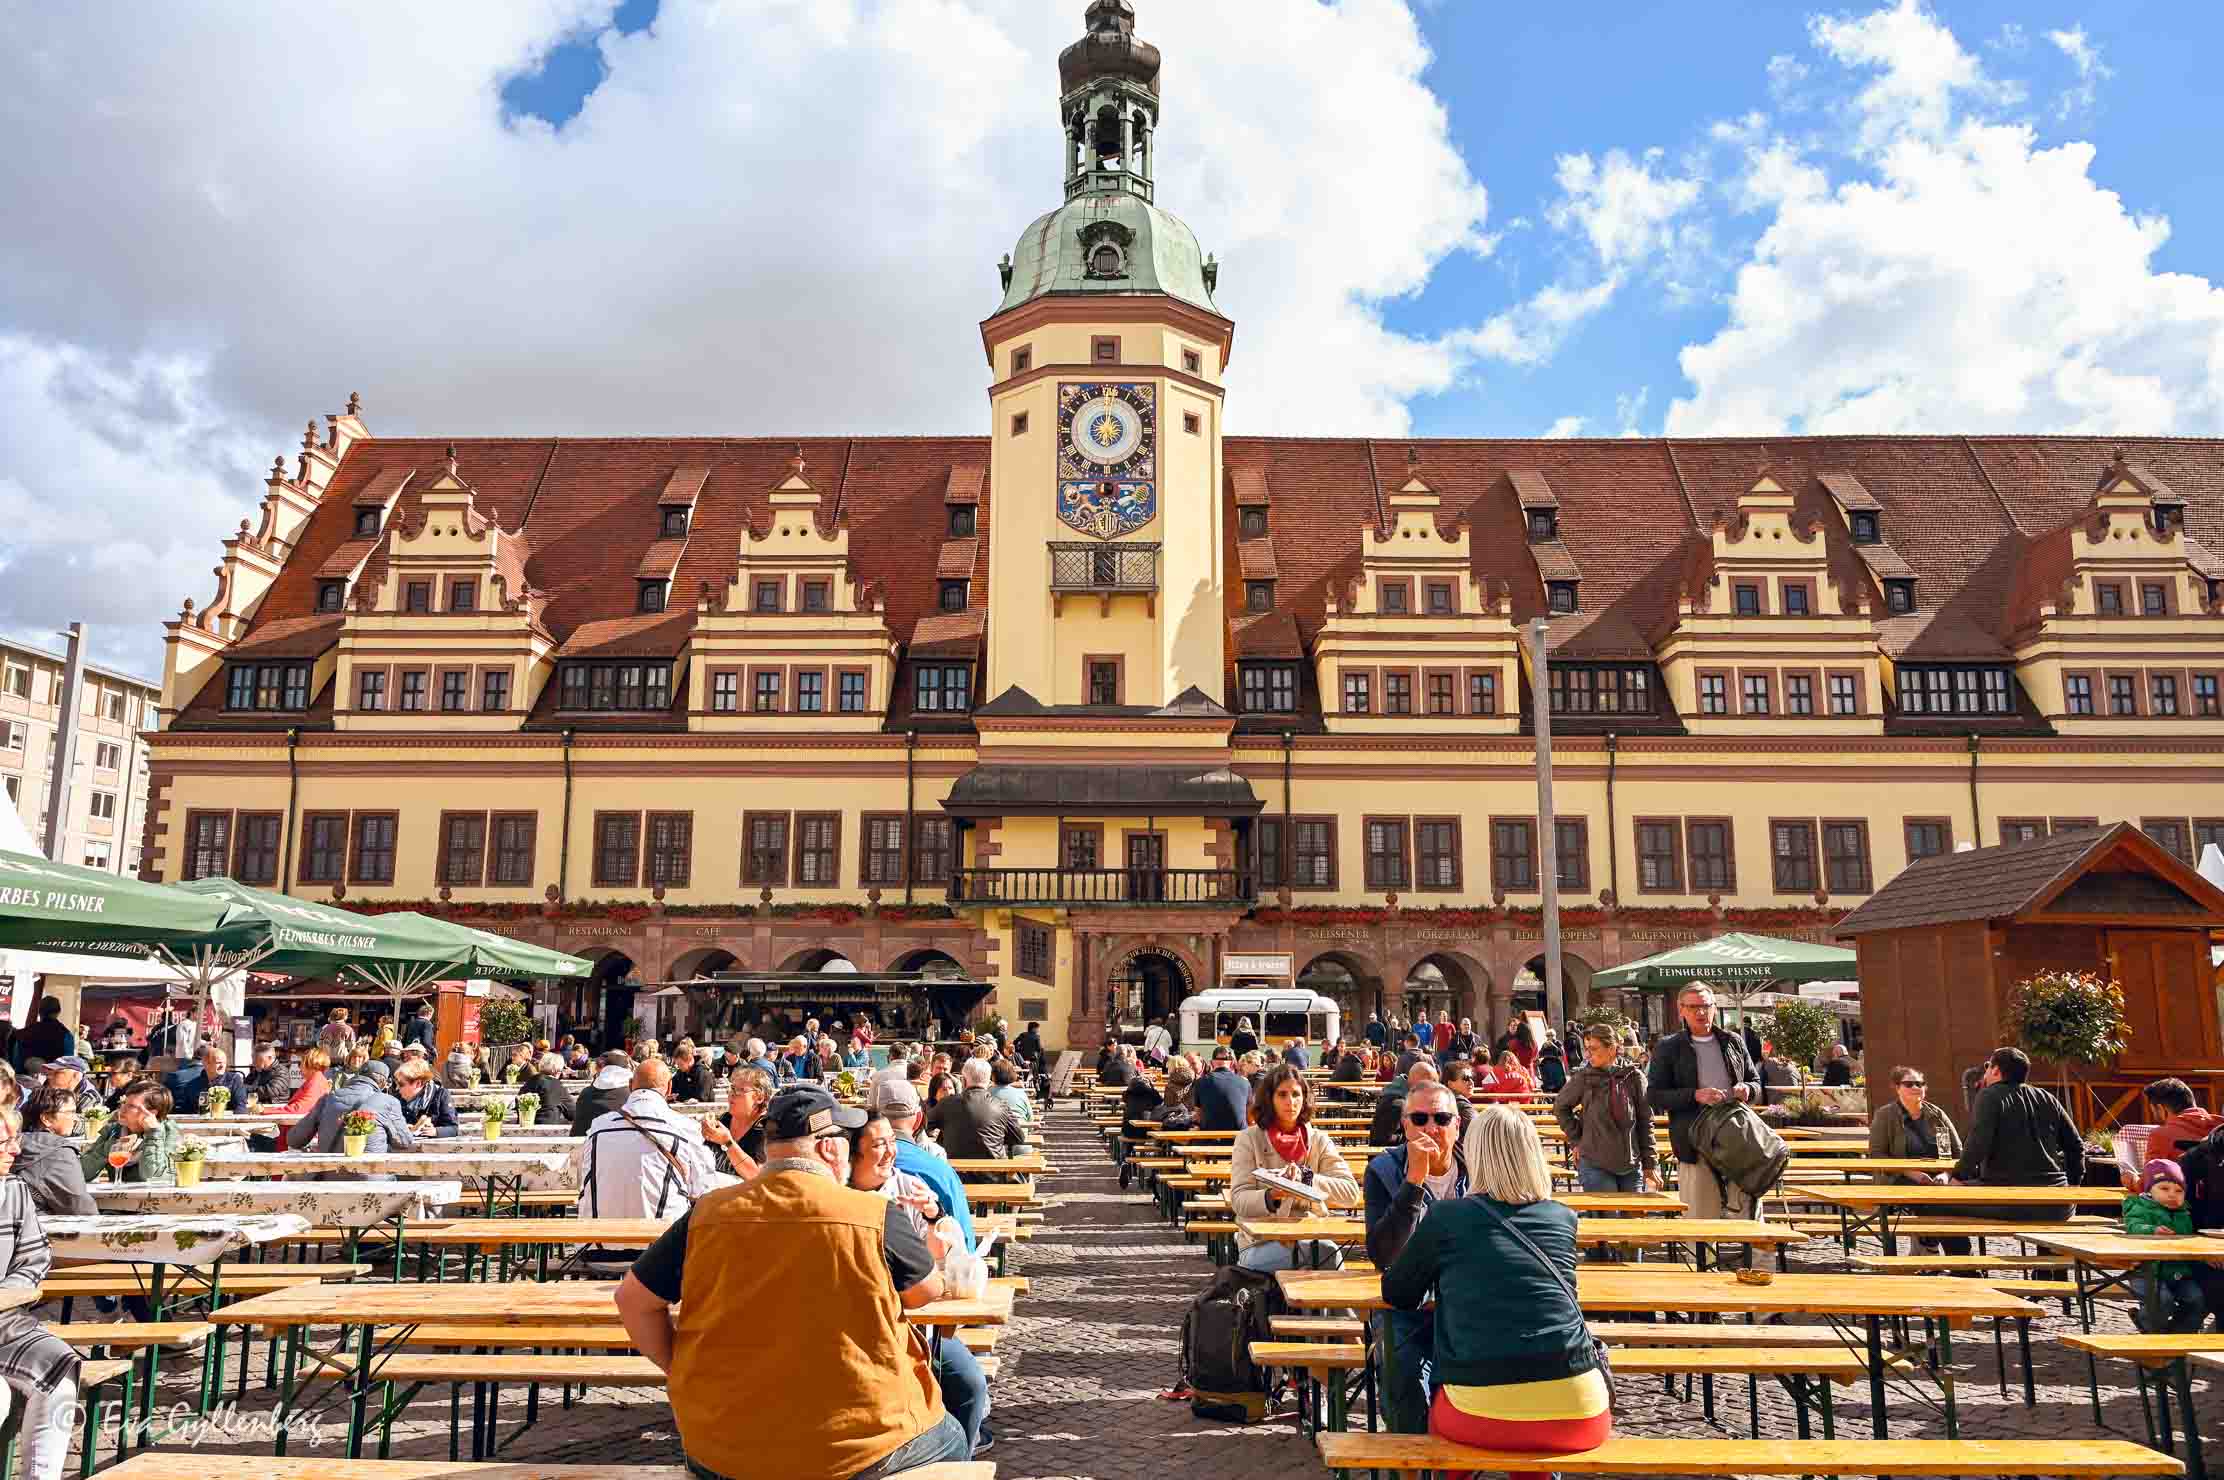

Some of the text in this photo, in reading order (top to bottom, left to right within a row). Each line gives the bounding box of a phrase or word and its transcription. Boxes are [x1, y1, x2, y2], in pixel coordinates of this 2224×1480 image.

[0, 887, 105, 913] RBES PILSNER
[568, 927, 632, 936] RESTAURANT
[1310, 928, 1369, 939] MEISSENER
[1558, 929, 1599, 940] ROPFEN
[337, 934, 377, 949] PILSNER
[1659, 965, 1772, 977] FEINHERBES PILSNER
